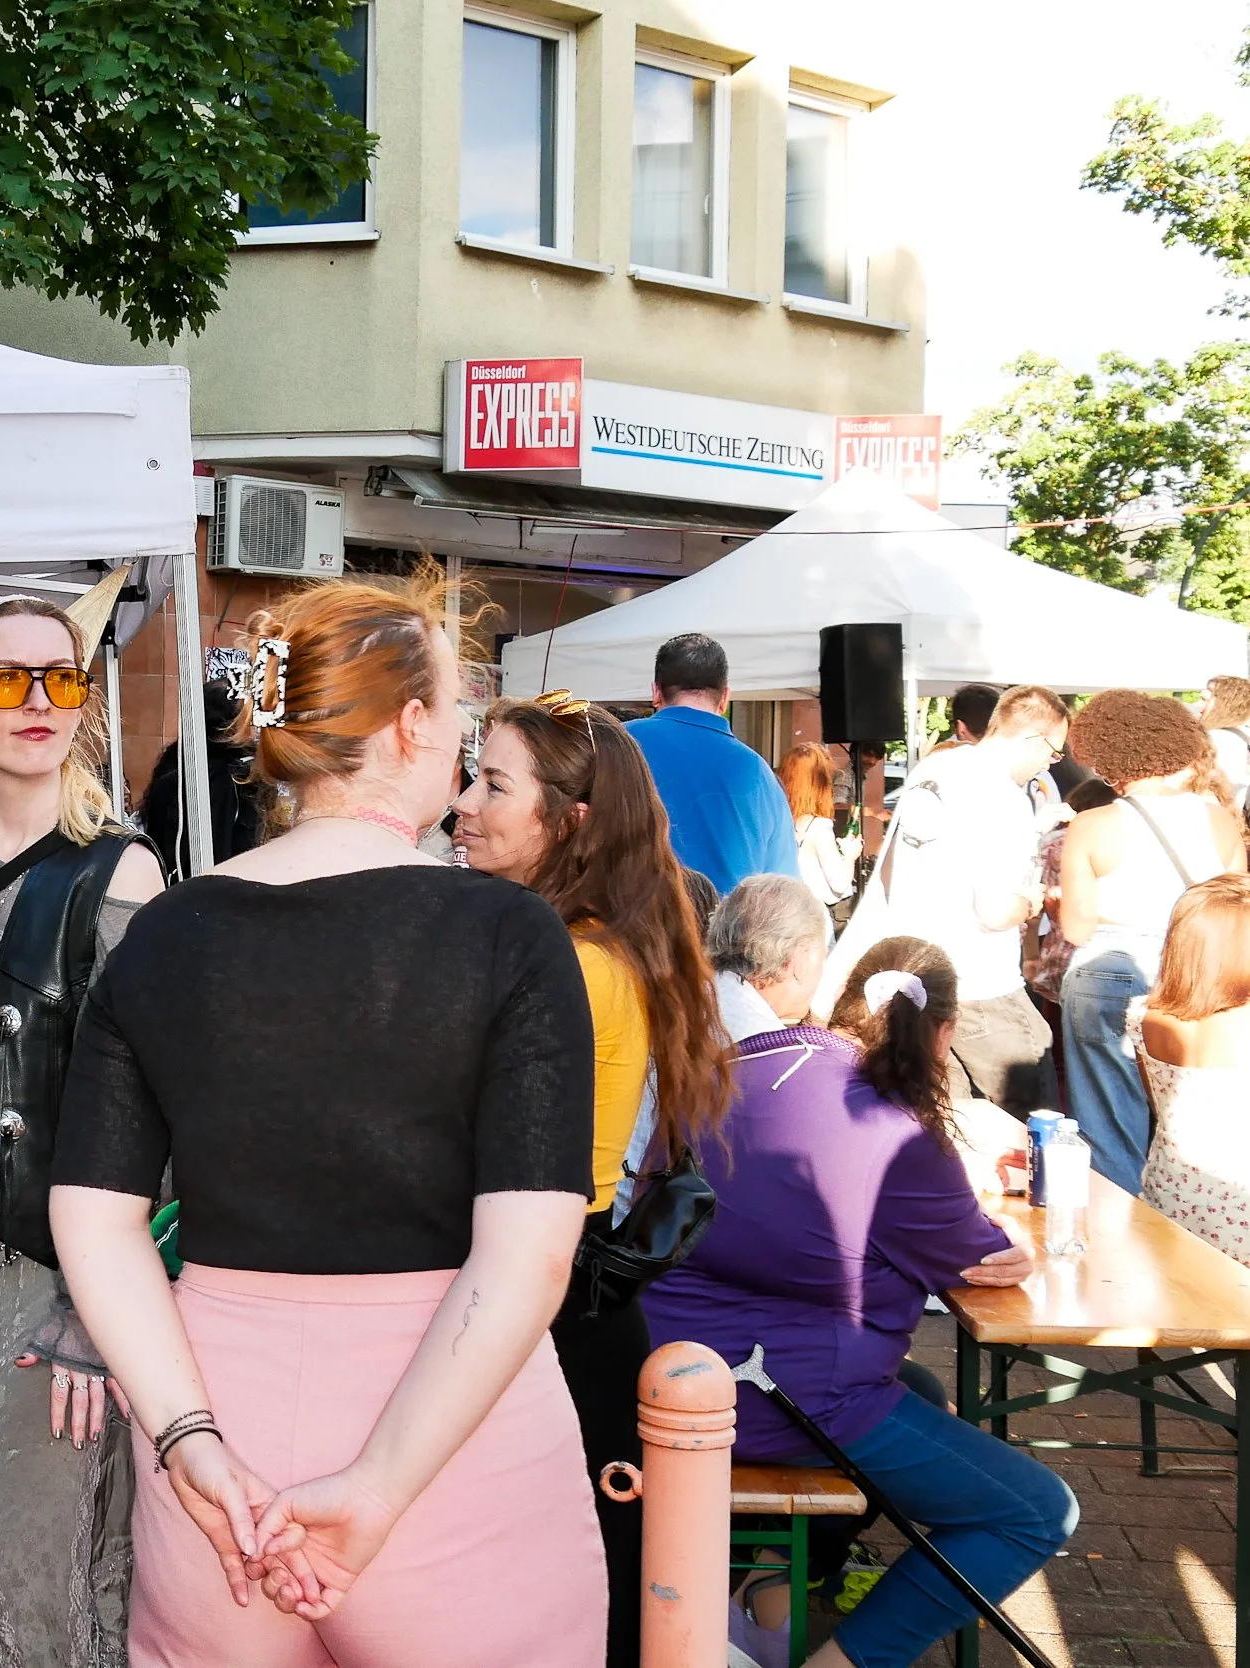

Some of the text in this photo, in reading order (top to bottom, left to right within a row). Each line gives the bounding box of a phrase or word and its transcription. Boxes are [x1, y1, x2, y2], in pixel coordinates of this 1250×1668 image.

[471, 365, 526, 380] Düsseldorf
[470, 382, 575, 449] EXPRESS
[592, 415, 823, 470] WESTDEUTSCHE ZEITUNG
[315, 500, 341, 508] ALASKA
